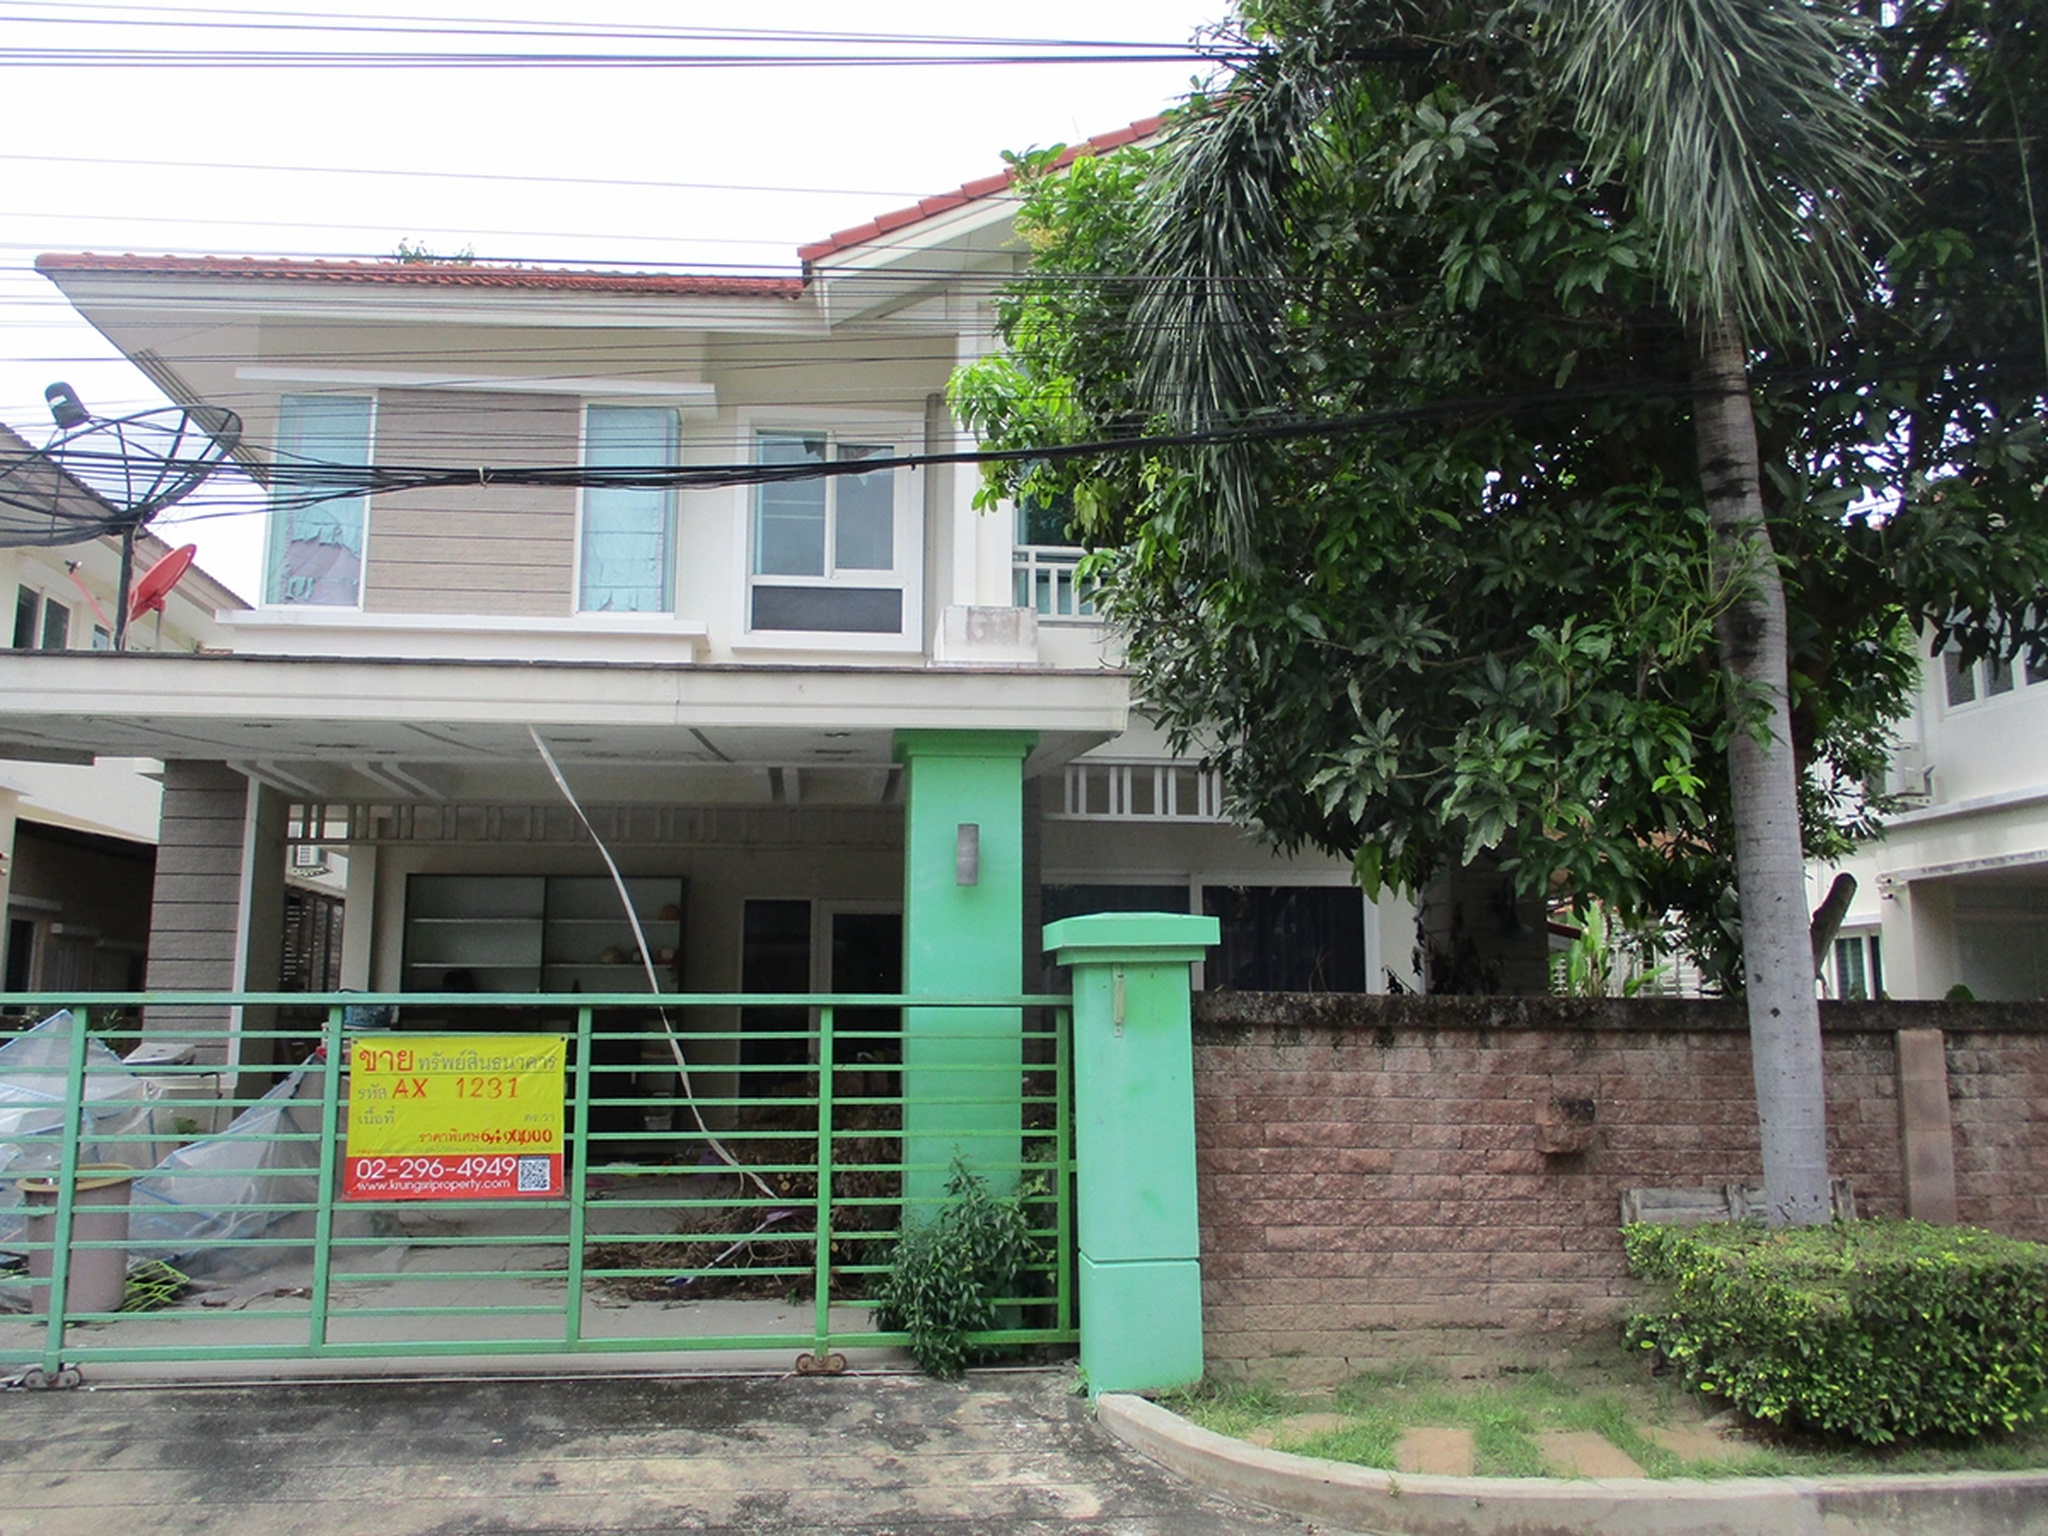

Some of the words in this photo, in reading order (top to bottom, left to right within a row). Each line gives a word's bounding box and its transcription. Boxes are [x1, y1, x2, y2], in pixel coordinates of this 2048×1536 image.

[359, 1048, 414, 1072] ขาย
[418, 1050, 557, 1070] ทรัพย์สินธนาคาร
[358, 1083, 387, 1099] รหัส
[392, 1078, 428, 1099] AX
[456, 1077, 519, 1098] 1231
[356, 1157, 517, 1179] 02-296-4949
[357, 1179, 510, 1193] www.krungsriproperty.com
